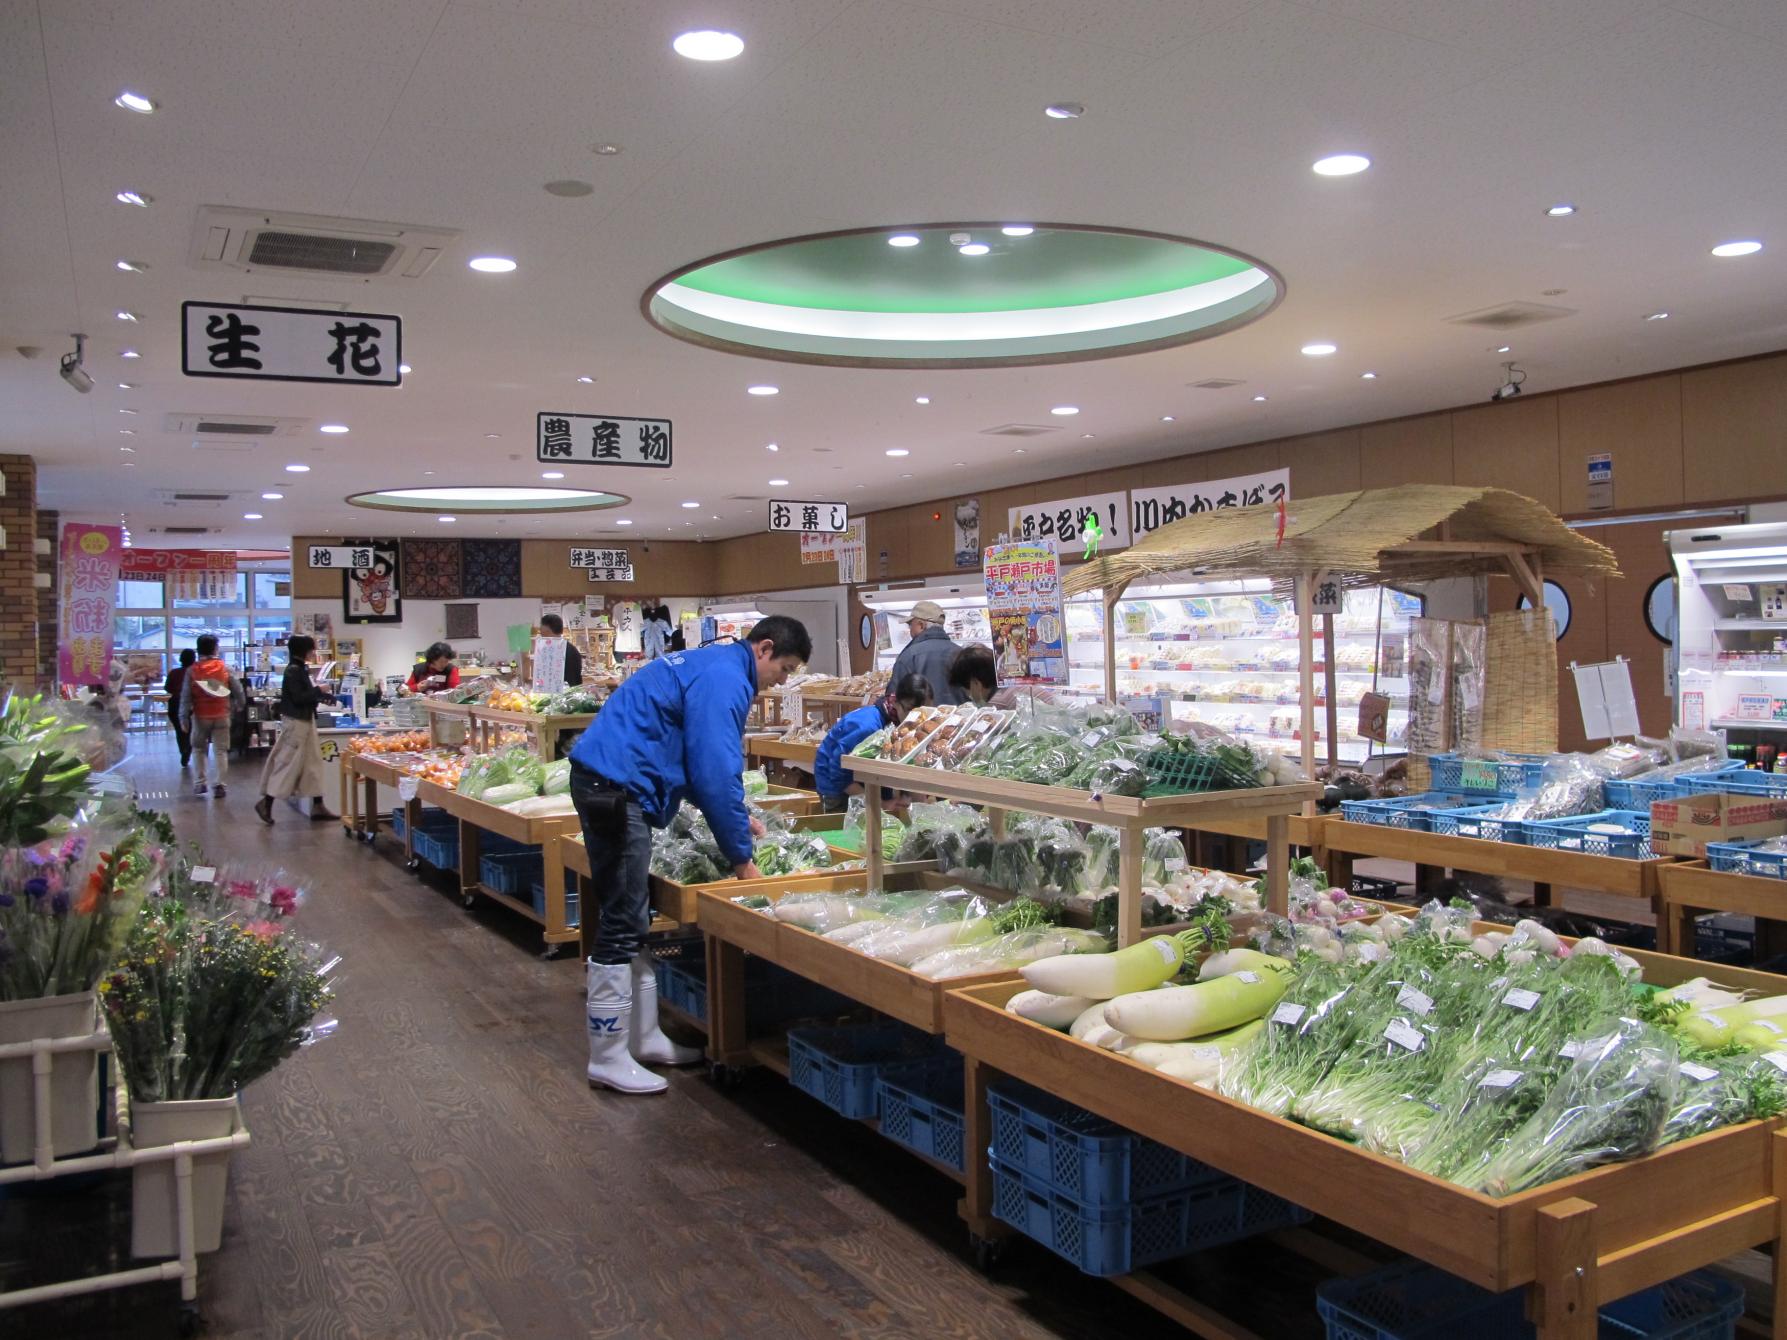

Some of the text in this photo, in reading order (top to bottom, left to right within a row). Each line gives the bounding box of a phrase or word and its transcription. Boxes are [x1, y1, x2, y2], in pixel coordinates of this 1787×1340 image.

[206, 312, 382, 376] 生花
[542, 417, 668, 462] 農産物
[773, 503, 845, 531] お菓し
[312, 548, 370, 567] 地酒
[986, 559, 1056, 580] 平戸瀬戸市場
